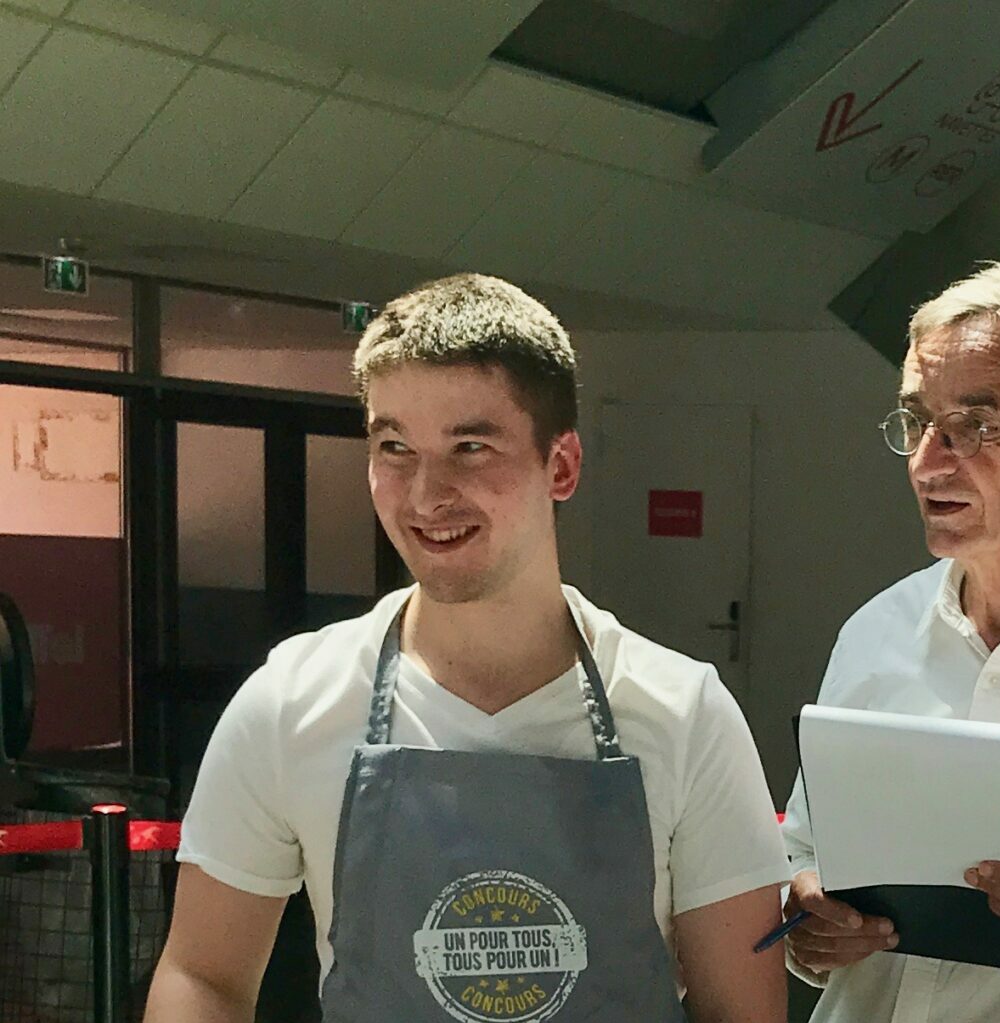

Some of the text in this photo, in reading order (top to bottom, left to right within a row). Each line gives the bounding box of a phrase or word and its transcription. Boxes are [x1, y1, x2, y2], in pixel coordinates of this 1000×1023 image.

[452, 887, 541, 915] CONCOURS
[444, 929, 557, 951] UN POUR TOUS,
[443, 953, 482, 971] TOUS
[486, 951, 526, 970] POUR
[530, 950, 551, 968] UN
[461, 984, 546, 1013] CONCOURS
